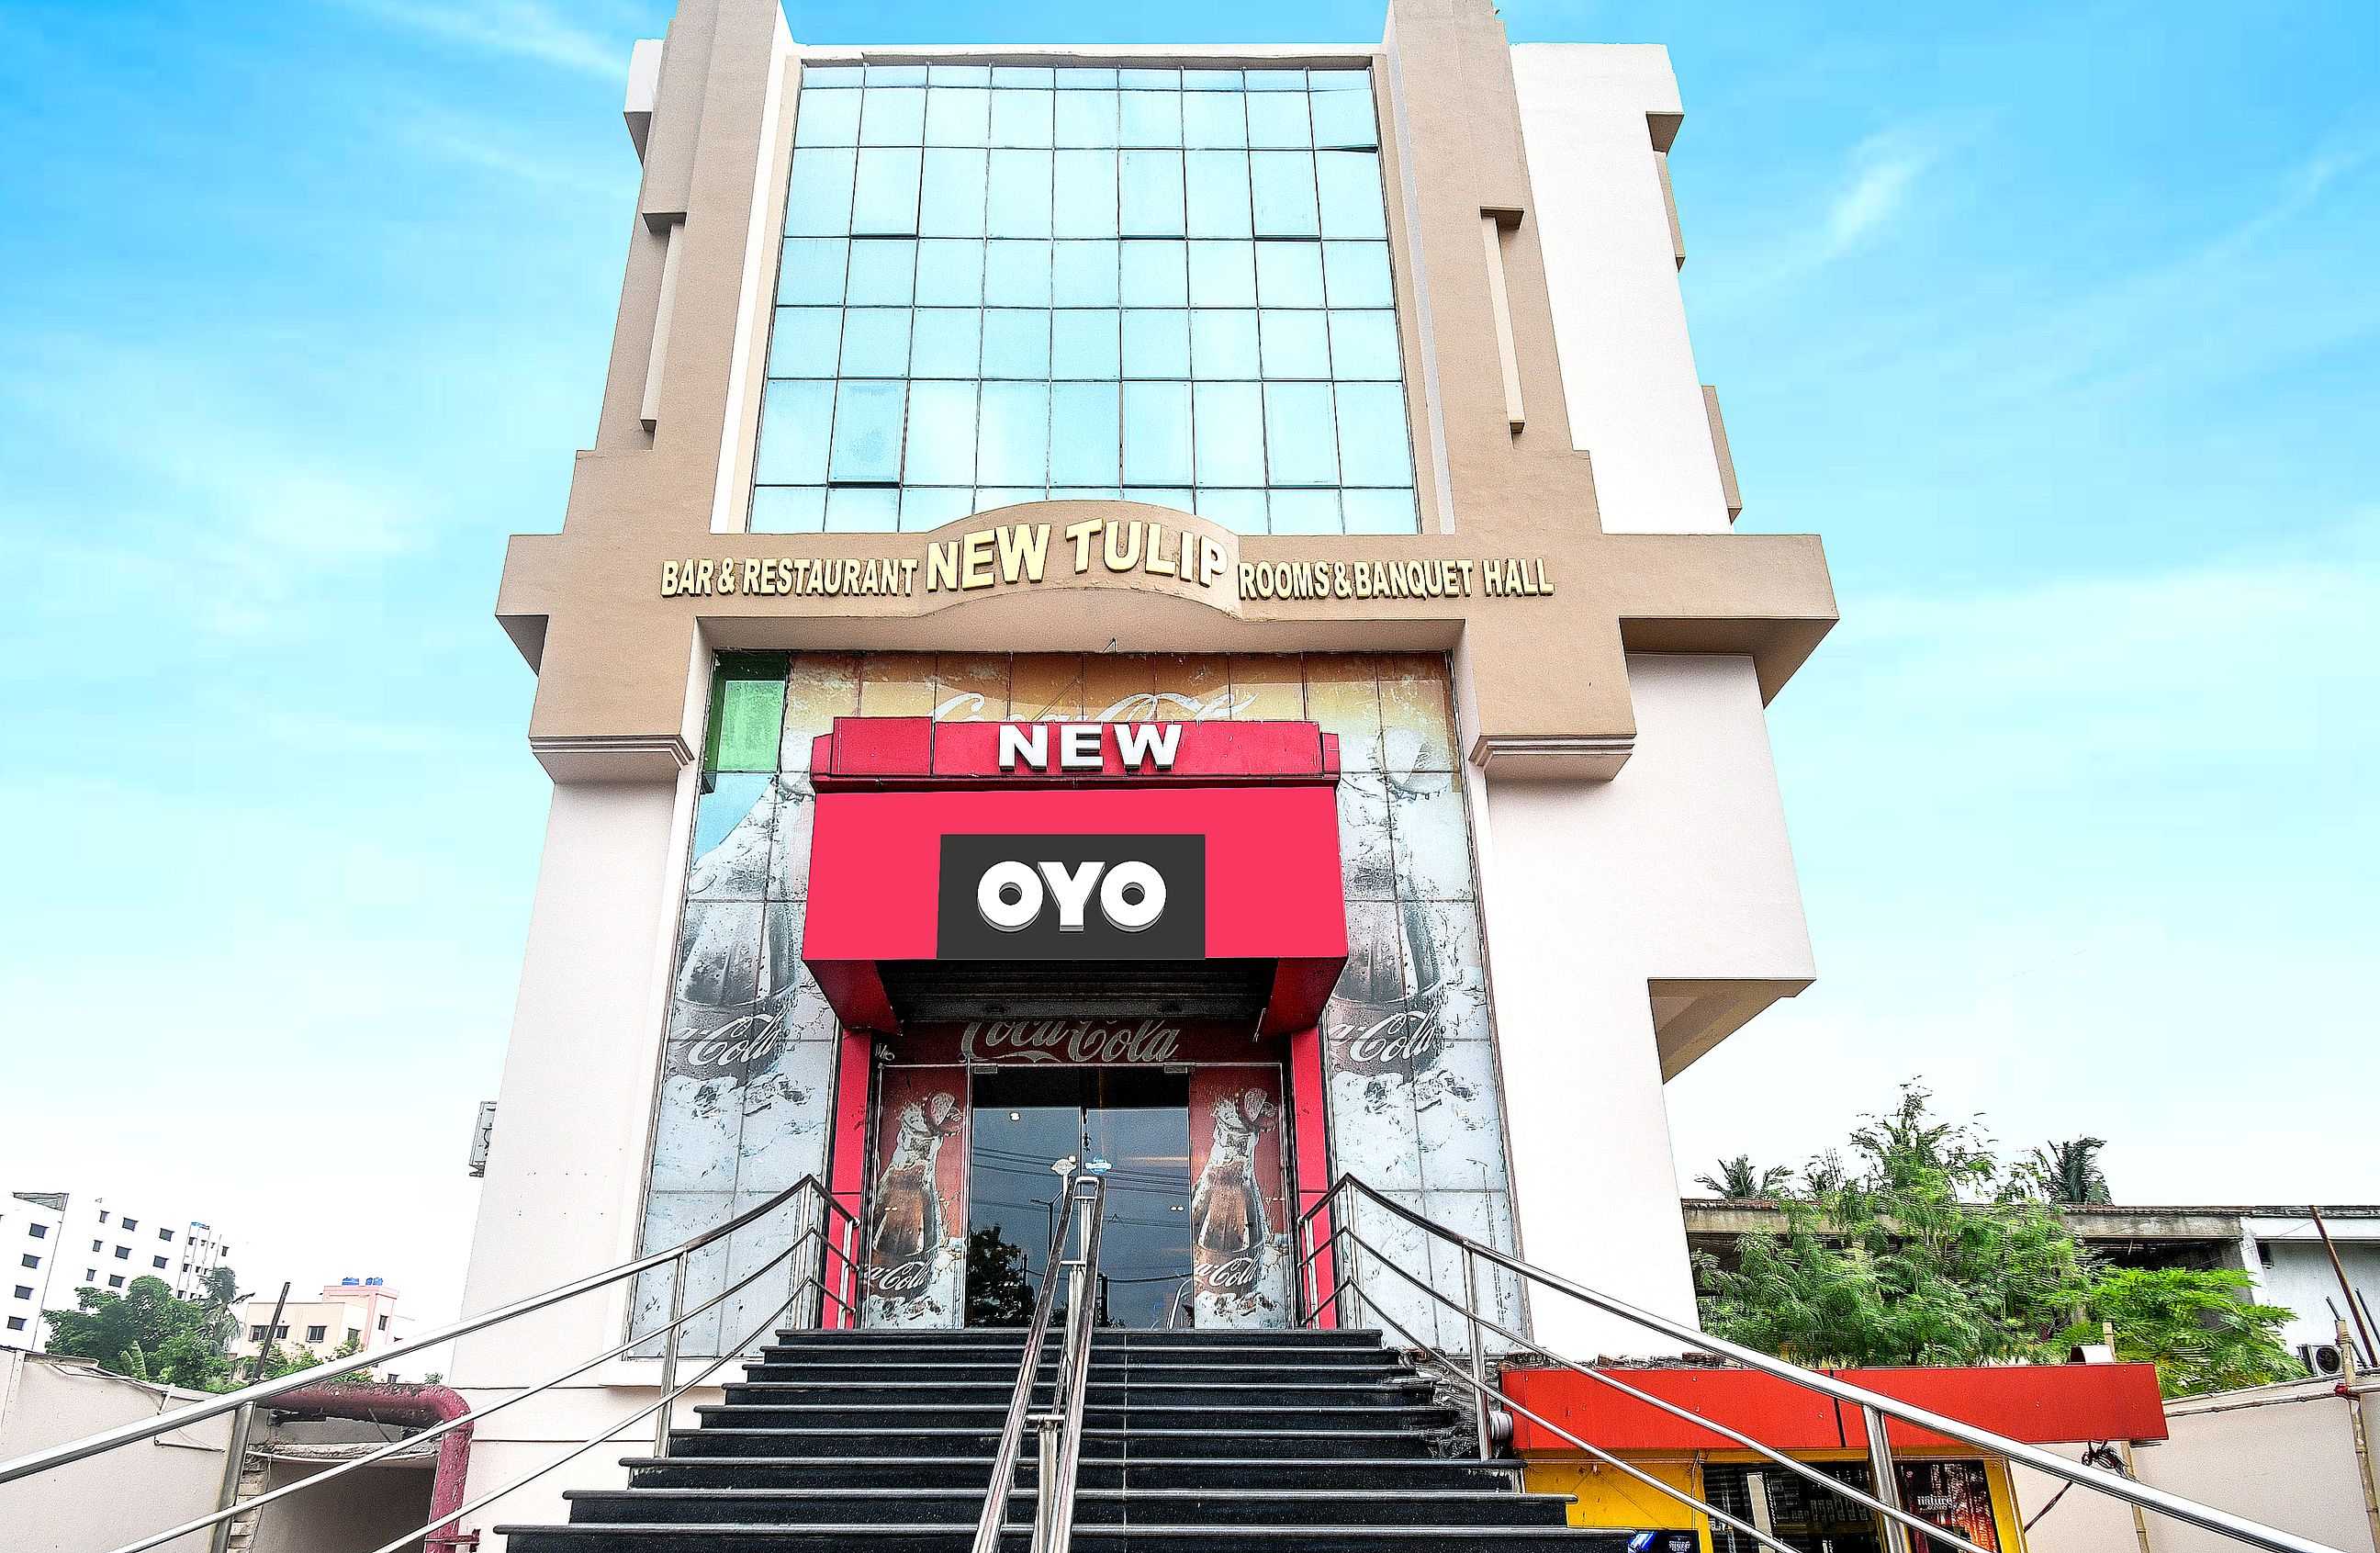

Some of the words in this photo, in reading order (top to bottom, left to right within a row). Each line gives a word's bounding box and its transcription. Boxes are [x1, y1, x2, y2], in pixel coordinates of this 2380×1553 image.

[660, 559, 714, 597] BAR
[741, 557, 918, 597] RESTAURANT
[926, 523, 1051, 592] NEW
[1065, 517, 1228, 588] TULIP
[1481, 557, 1555, 596] HALL
[997, 724, 1184, 772] NEW
[976, 860, 1168, 933] OYO
